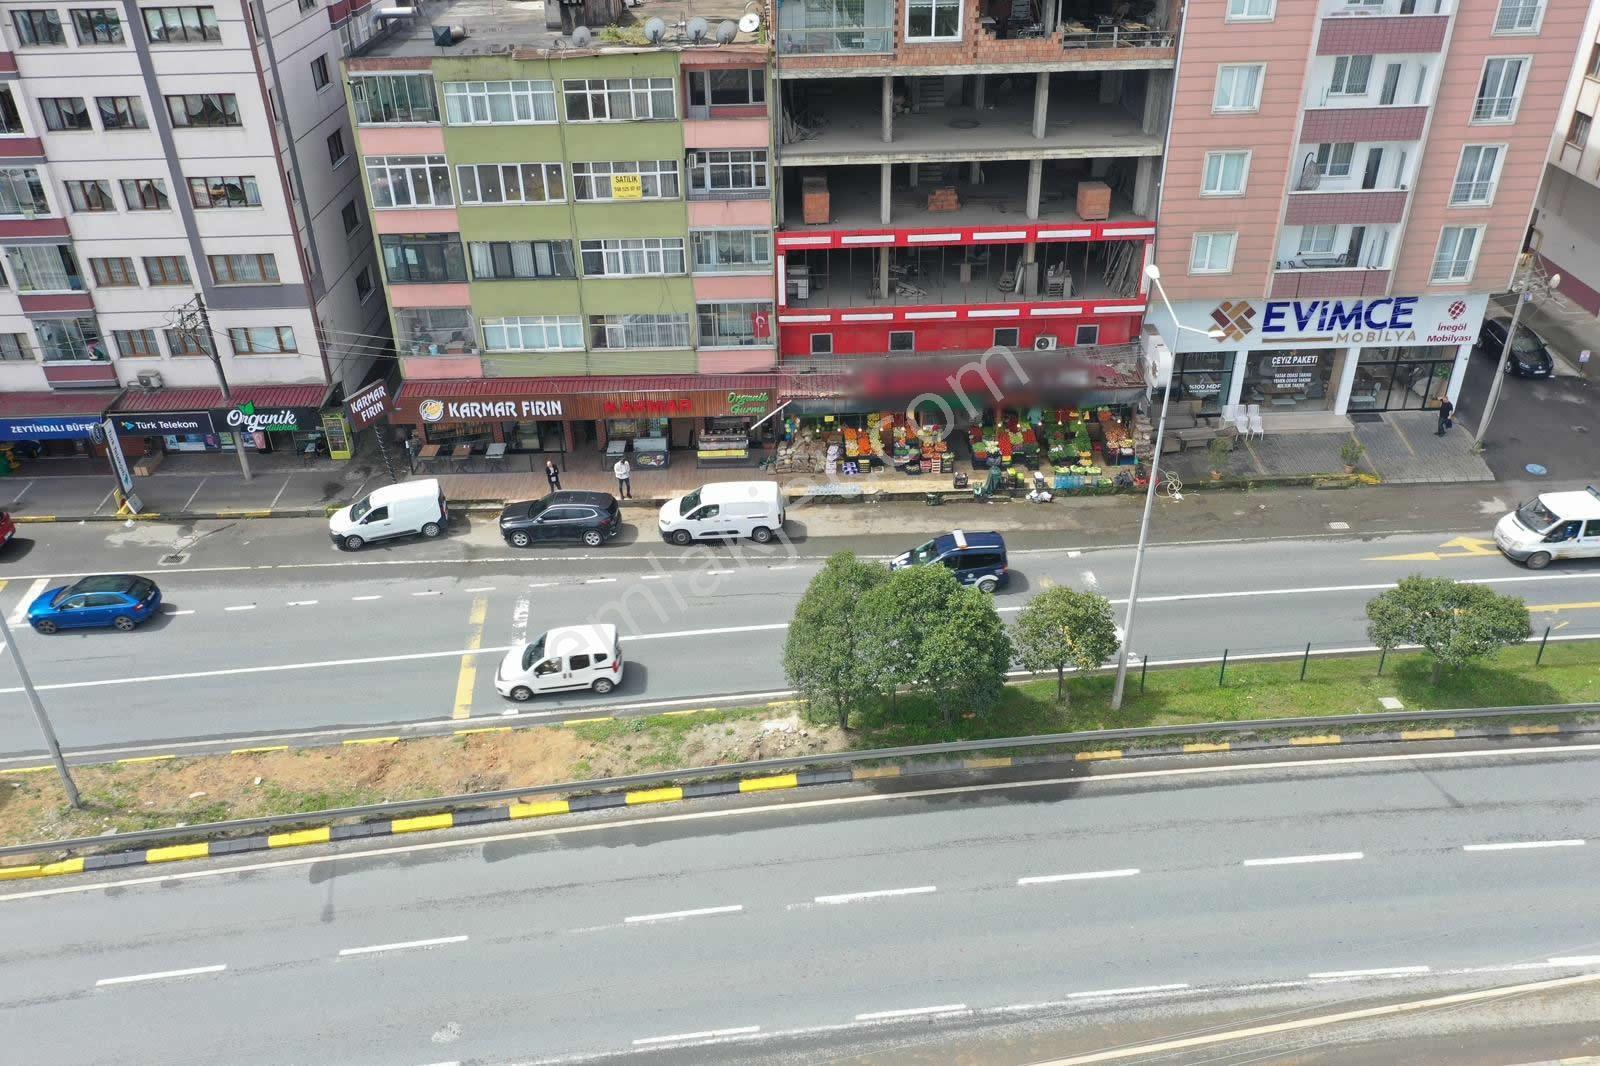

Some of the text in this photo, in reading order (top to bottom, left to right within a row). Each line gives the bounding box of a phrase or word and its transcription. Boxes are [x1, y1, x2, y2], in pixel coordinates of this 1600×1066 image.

[1437, 322, 1467, 333] İnegöl
[1336, 328, 1417, 343] MOBİLYA
[1427, 333, 1472, 343] Mobilyası
[350, 386, 386, 413] KARMAR
[728, 392, 768, 405] Organik
[361, 401, 384, 422] FIRIN
[448, 400, 562, 418] KARMAR FIRIN
[136, 421, 198, 429] Türk Telekom
[227, 409, 296, 432] Organik
[11, 424, 65, 433] ZEYTİNDALI
